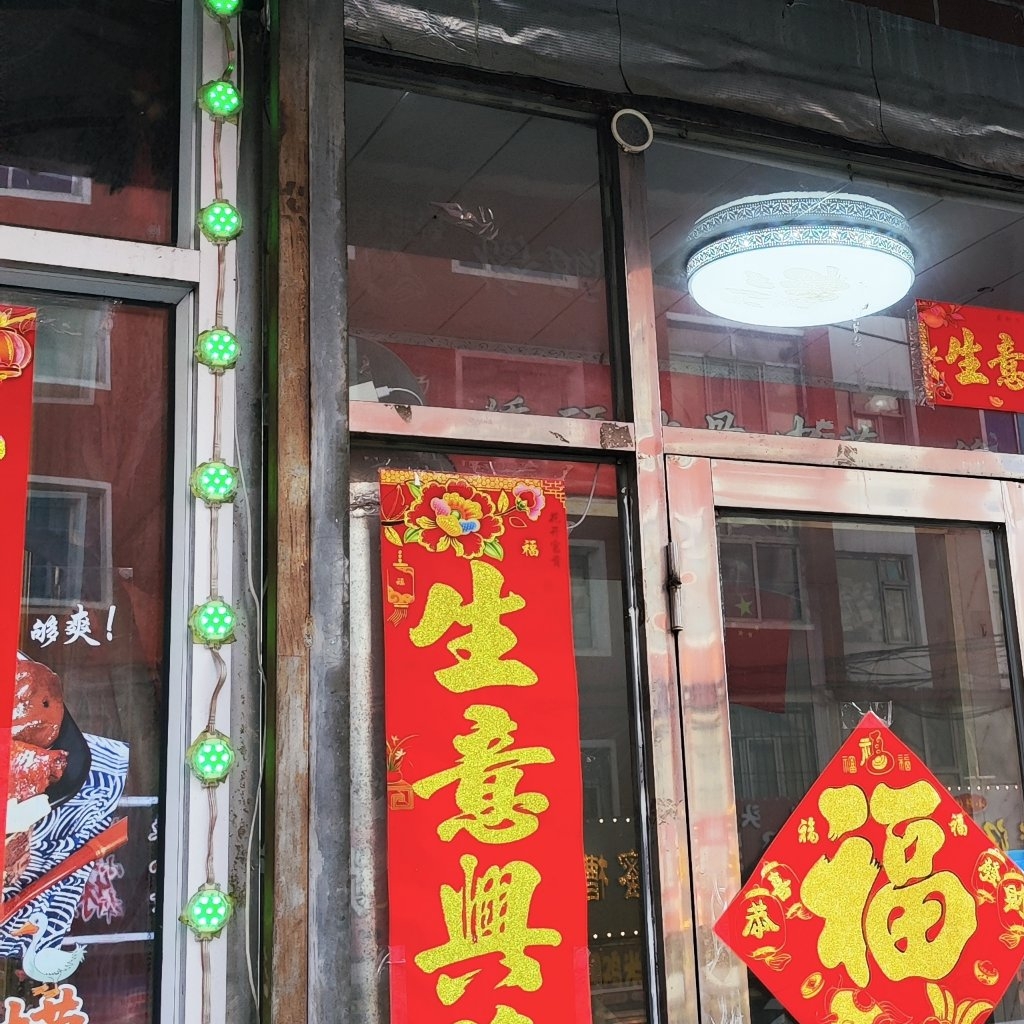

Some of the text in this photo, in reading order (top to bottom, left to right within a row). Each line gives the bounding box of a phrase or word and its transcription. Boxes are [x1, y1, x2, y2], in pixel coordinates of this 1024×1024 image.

[409, 560, 566, 1024] 生意興
[799, 779, 979, 989] 福
